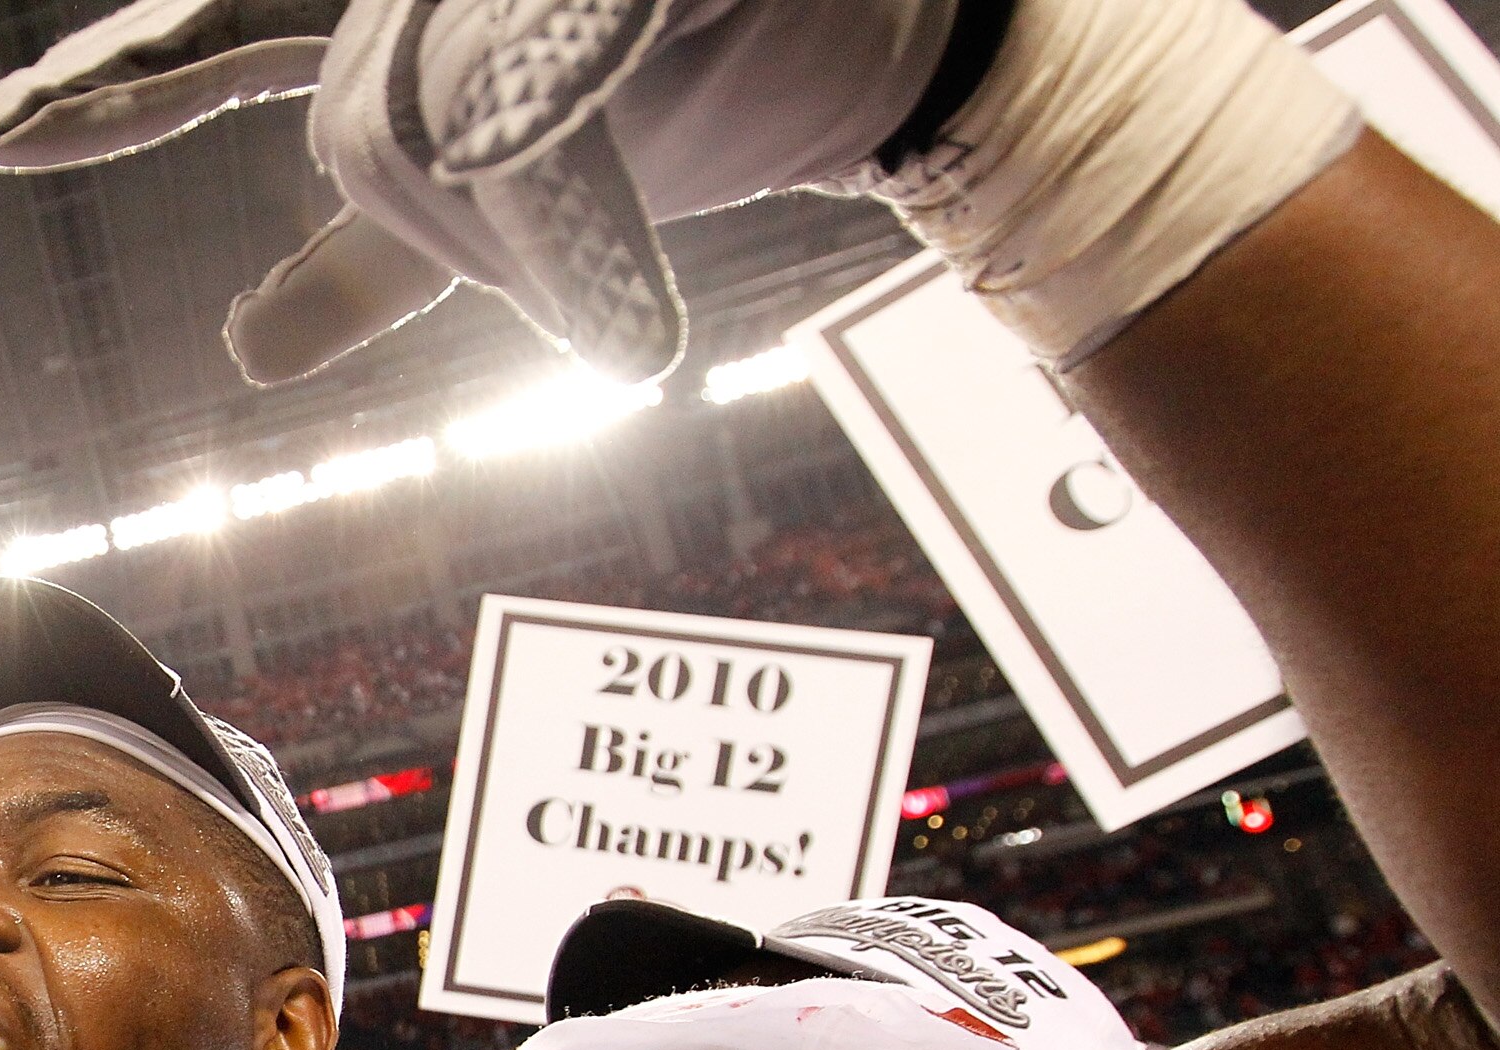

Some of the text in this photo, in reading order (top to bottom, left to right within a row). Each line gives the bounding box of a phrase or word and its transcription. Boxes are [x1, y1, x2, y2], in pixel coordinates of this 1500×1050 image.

[597, 645, 794, 714] 2010
[575, 719, 790, 796] Big 12
[525, 795, 814, 884] Champs!
